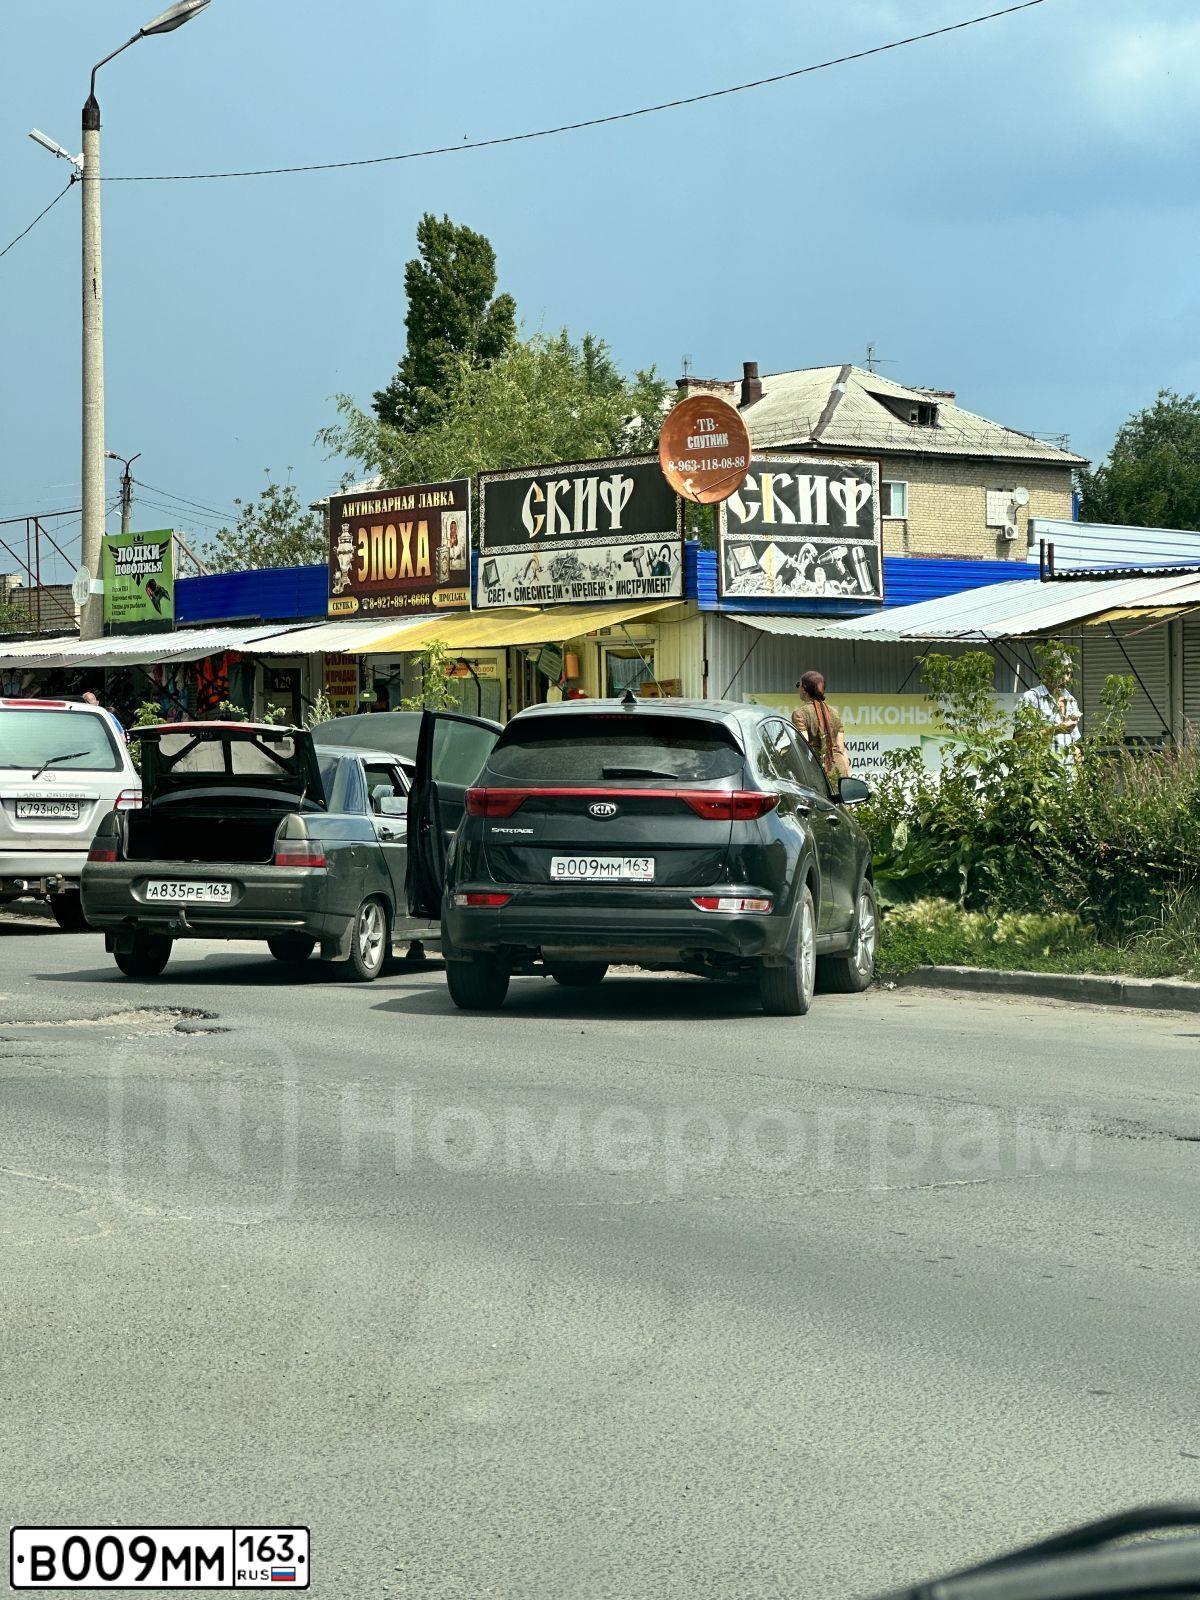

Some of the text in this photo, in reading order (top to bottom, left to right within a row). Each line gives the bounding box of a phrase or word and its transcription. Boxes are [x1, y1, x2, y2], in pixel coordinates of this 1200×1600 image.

[697, 417, 716, 432] ТВ
[687, 433, 729, 449] СПУТНИК
[668, 456, 745, 472] 8-963-118-08-88
[342, 490, 455, 518] АНТИКВАРНАЯ ЛАВКА
[522, 474, 634, 539] СКИФ
[727, 472, 872, 527] СКИФ
[117, 544, 160, 563] ЛОДКИ
[357, 520, 432, 582] ЭПОХА
[115, 561, 163, 576] ПОВОЛЖЬЯ
[438, 591, 467, 602] ПРОДАЖА
[488, 577, 672, 603] СВЕТ СМЕСИТЕЛИ КРЕПЕЖ ИНСТРУМЕНТ
[332, 602, 353, 611] СКУПКА
[369, 593, 430, 609] 8-927-897-6666
[838, 705, 933, 725] АЛКОНЫ
[844, 741, 879, 752] КИДКИ
[20, 803, 76, 814] К793НО 763
[593, 805, 612, 814] KIA
[556, 859, 649, 875] В009ММ 163
[151, 884, 228, 898] А835РЕ 163
